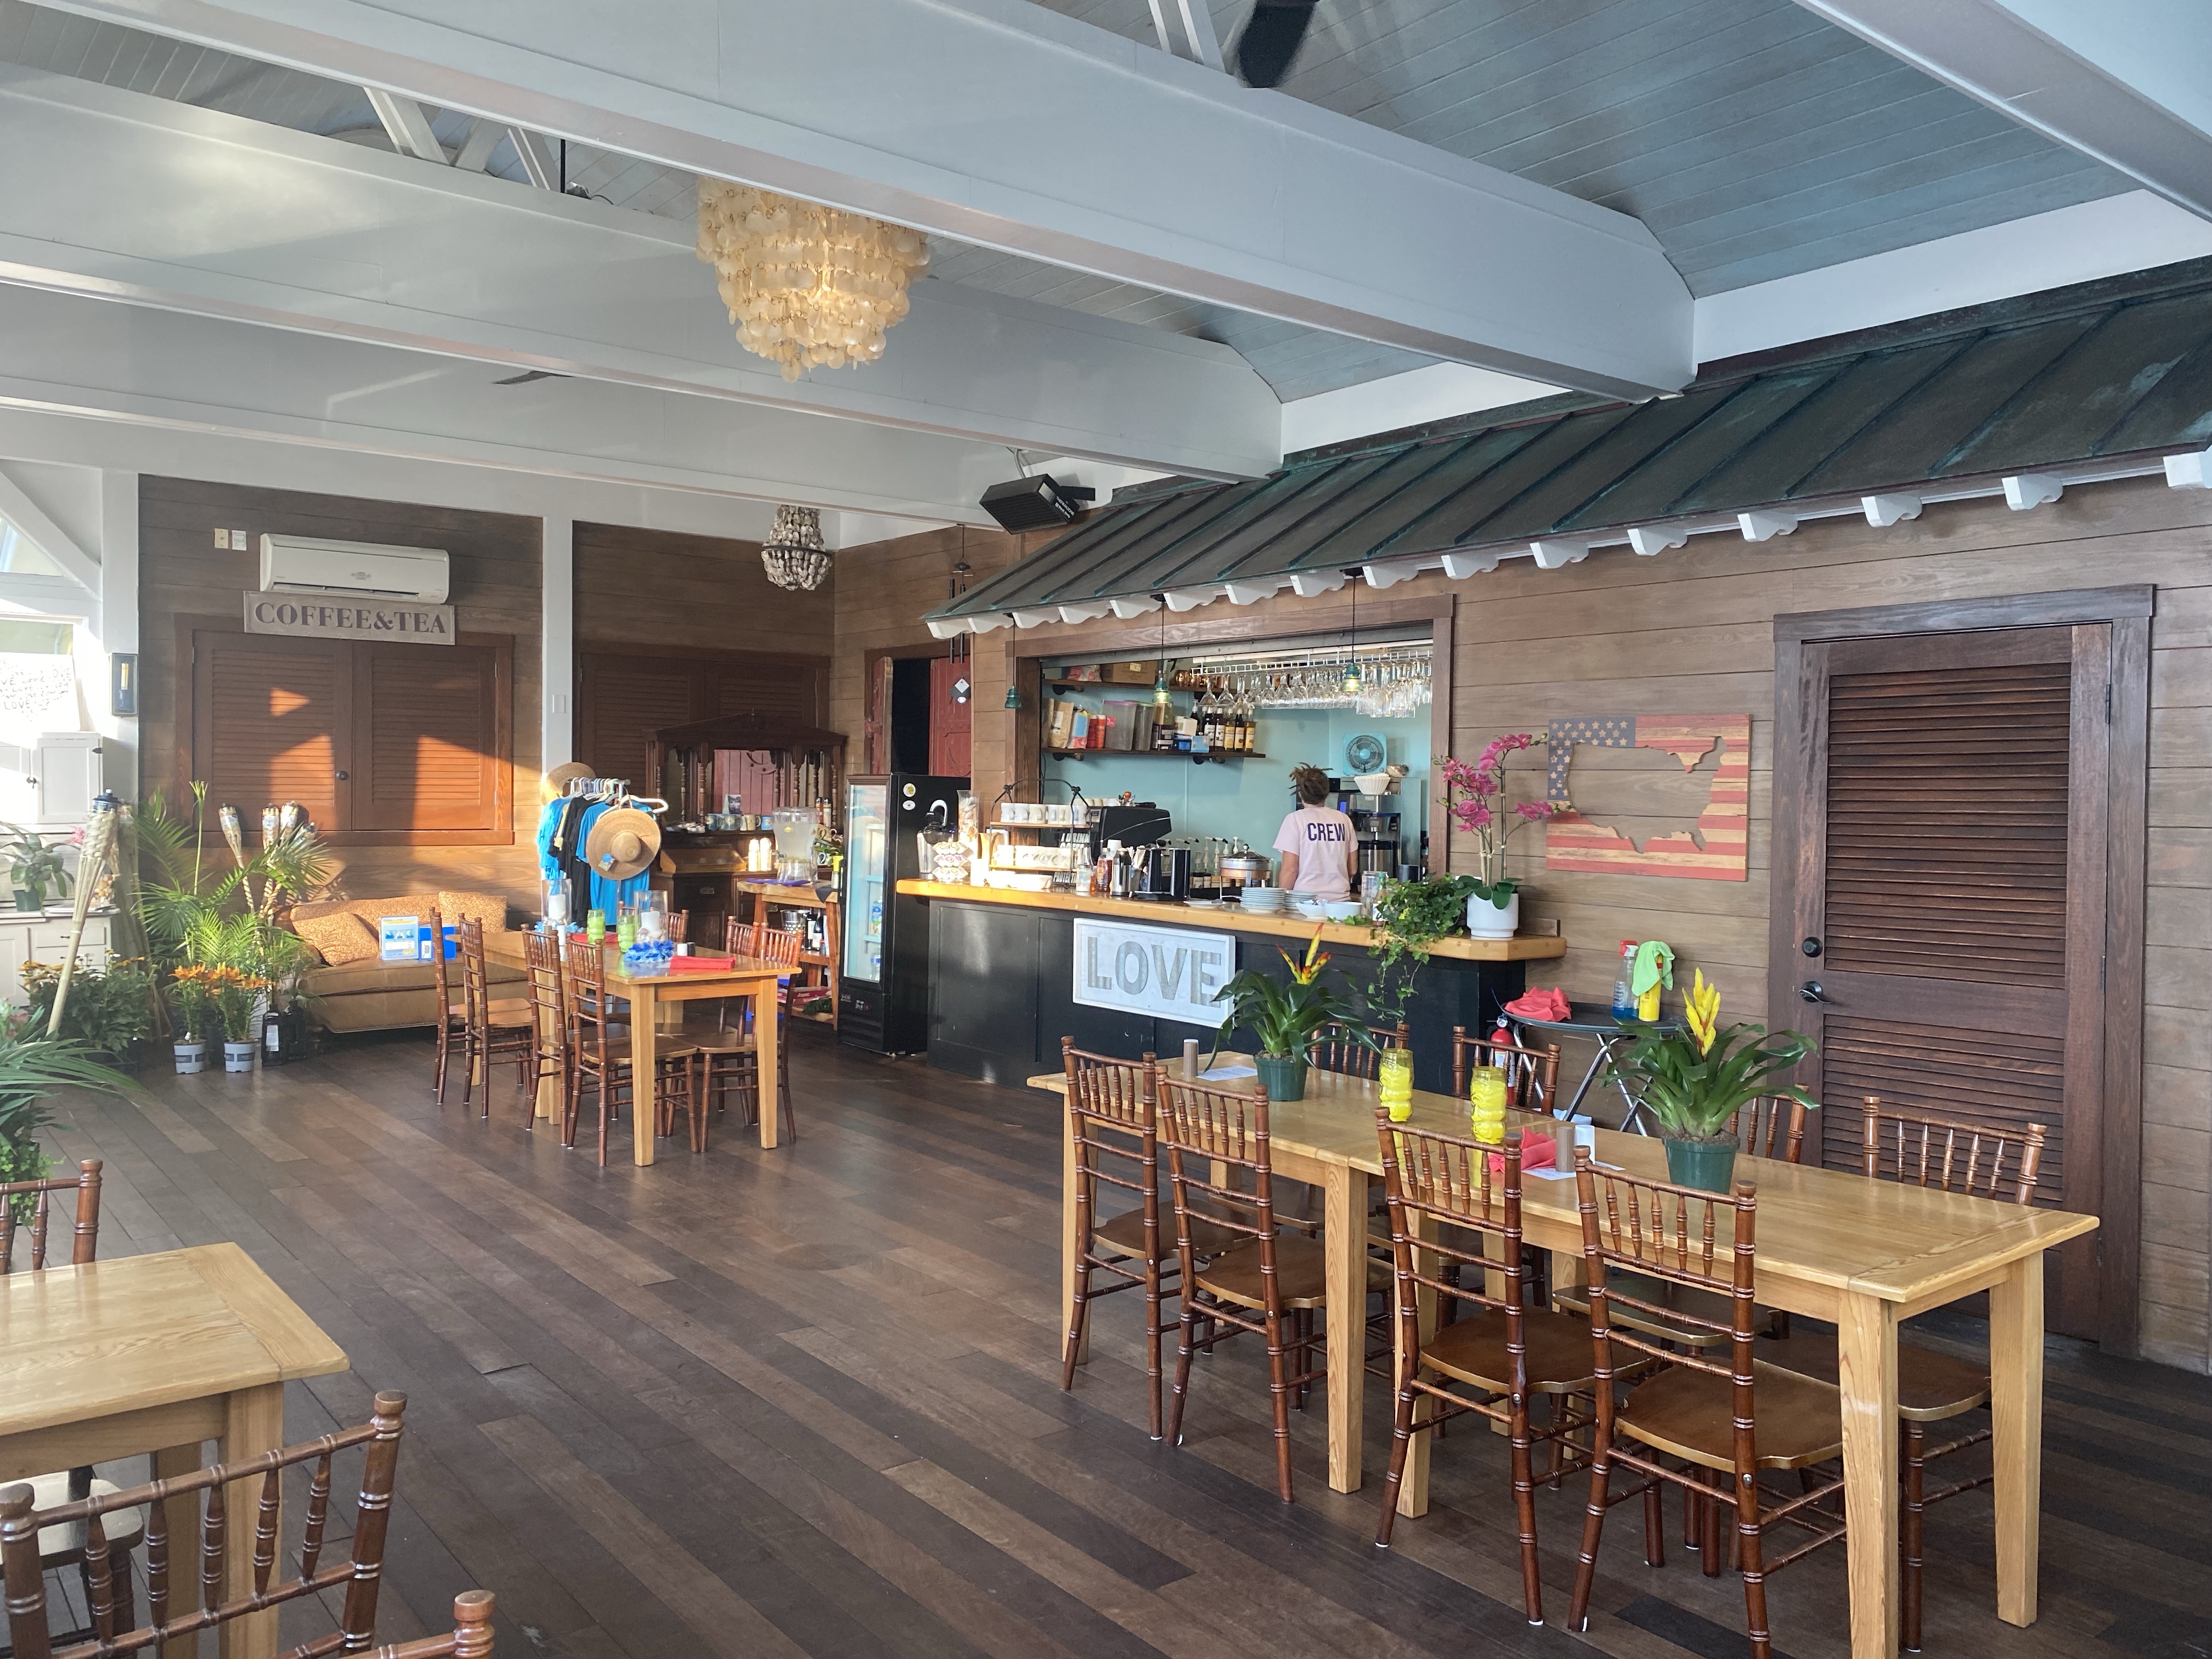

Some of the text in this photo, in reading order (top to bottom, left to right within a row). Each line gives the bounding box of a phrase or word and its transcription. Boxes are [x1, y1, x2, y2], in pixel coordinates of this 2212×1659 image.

[255, 602, 447, 634] COFFEE&TEA
[3, 699, 31, 710] LOVE
[1060, 833, 1065, 842] I
[1307, 822, 1346, 842] CREW
[1087, 936, 1221, 1008] LOVE
